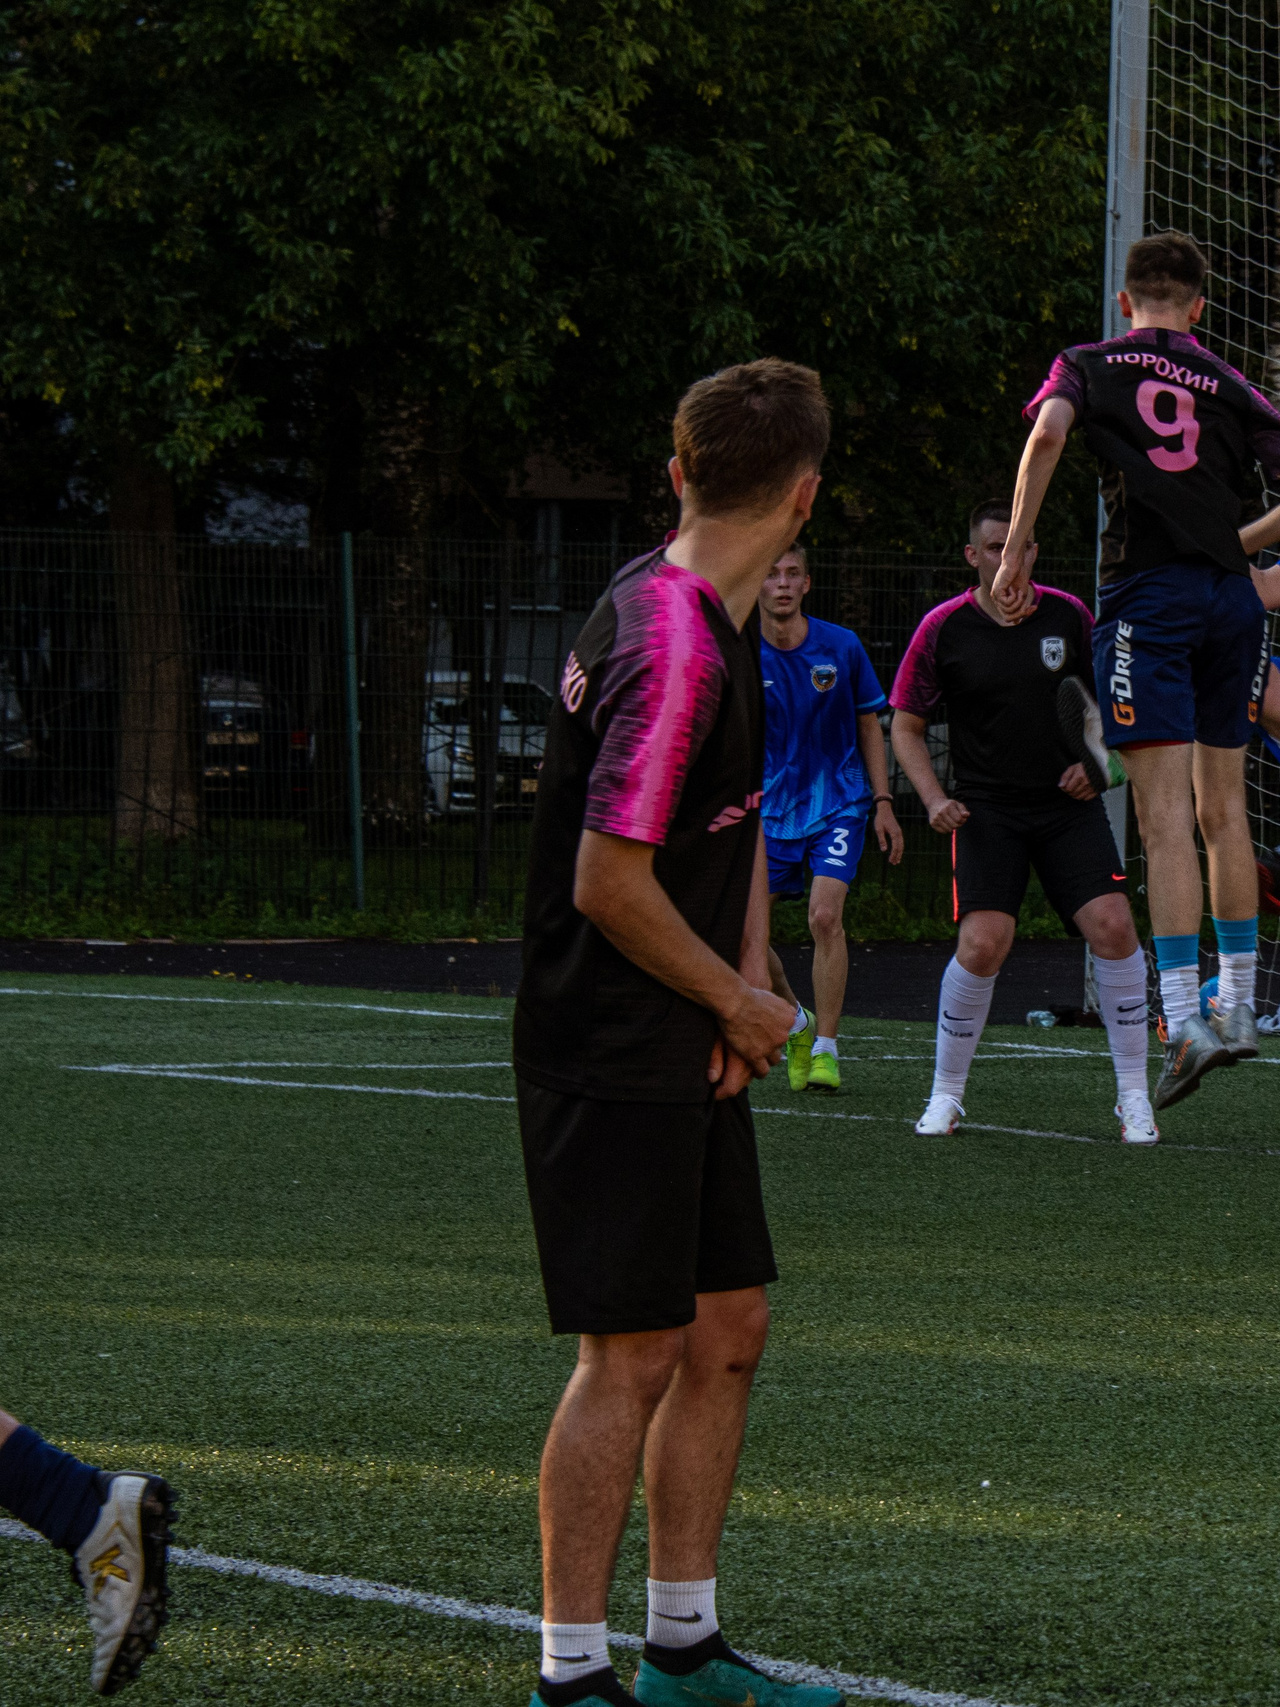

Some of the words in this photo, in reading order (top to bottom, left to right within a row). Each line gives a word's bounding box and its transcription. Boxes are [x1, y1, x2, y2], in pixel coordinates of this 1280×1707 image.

[1104, 352, 1219, 395] ПОРОХИН
[1135, 379, 1201, 473] 9
[1109, 619, 1136, 727] G-DRIVE
[827, 827, 850, 857] 3
